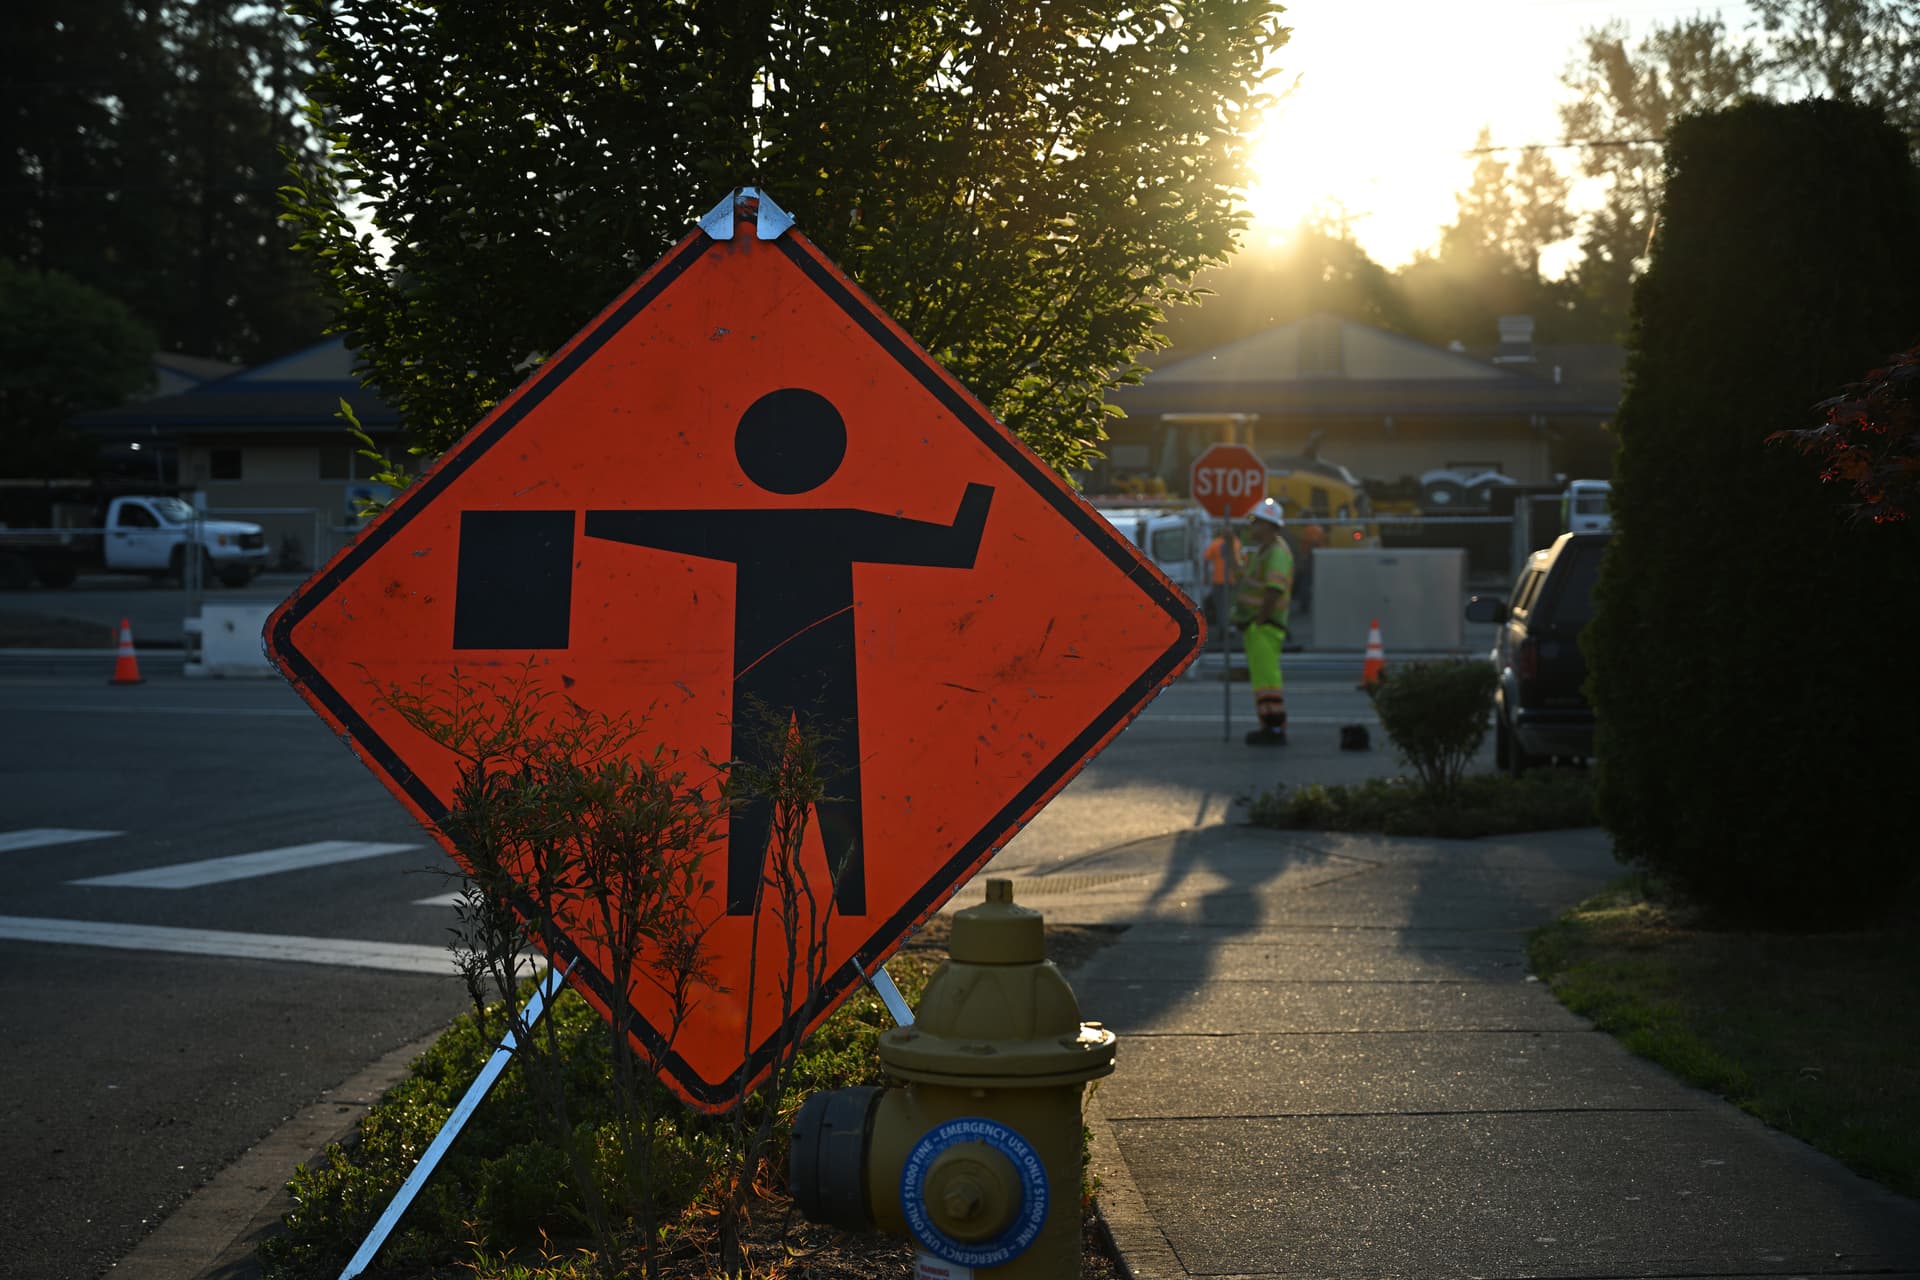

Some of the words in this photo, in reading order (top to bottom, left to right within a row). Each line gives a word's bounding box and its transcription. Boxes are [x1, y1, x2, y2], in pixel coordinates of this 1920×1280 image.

[1197, 467, 1261, 497] STOP
[939, 1121, 1009, 1140] EMERGENCY
[912, 1139, 934, 1164] FINE
[1008, 1136, 1029, 1158] USE
[1024, 1156, 1044, 1185] ONLY
[904, 1201, 925, 1230] ONLY
[919, 1229, 941, 1250] USE
[1015, 1222, 1038, 1247] FINE
[941, 1247, 1010, 1264] EMERGENCY
